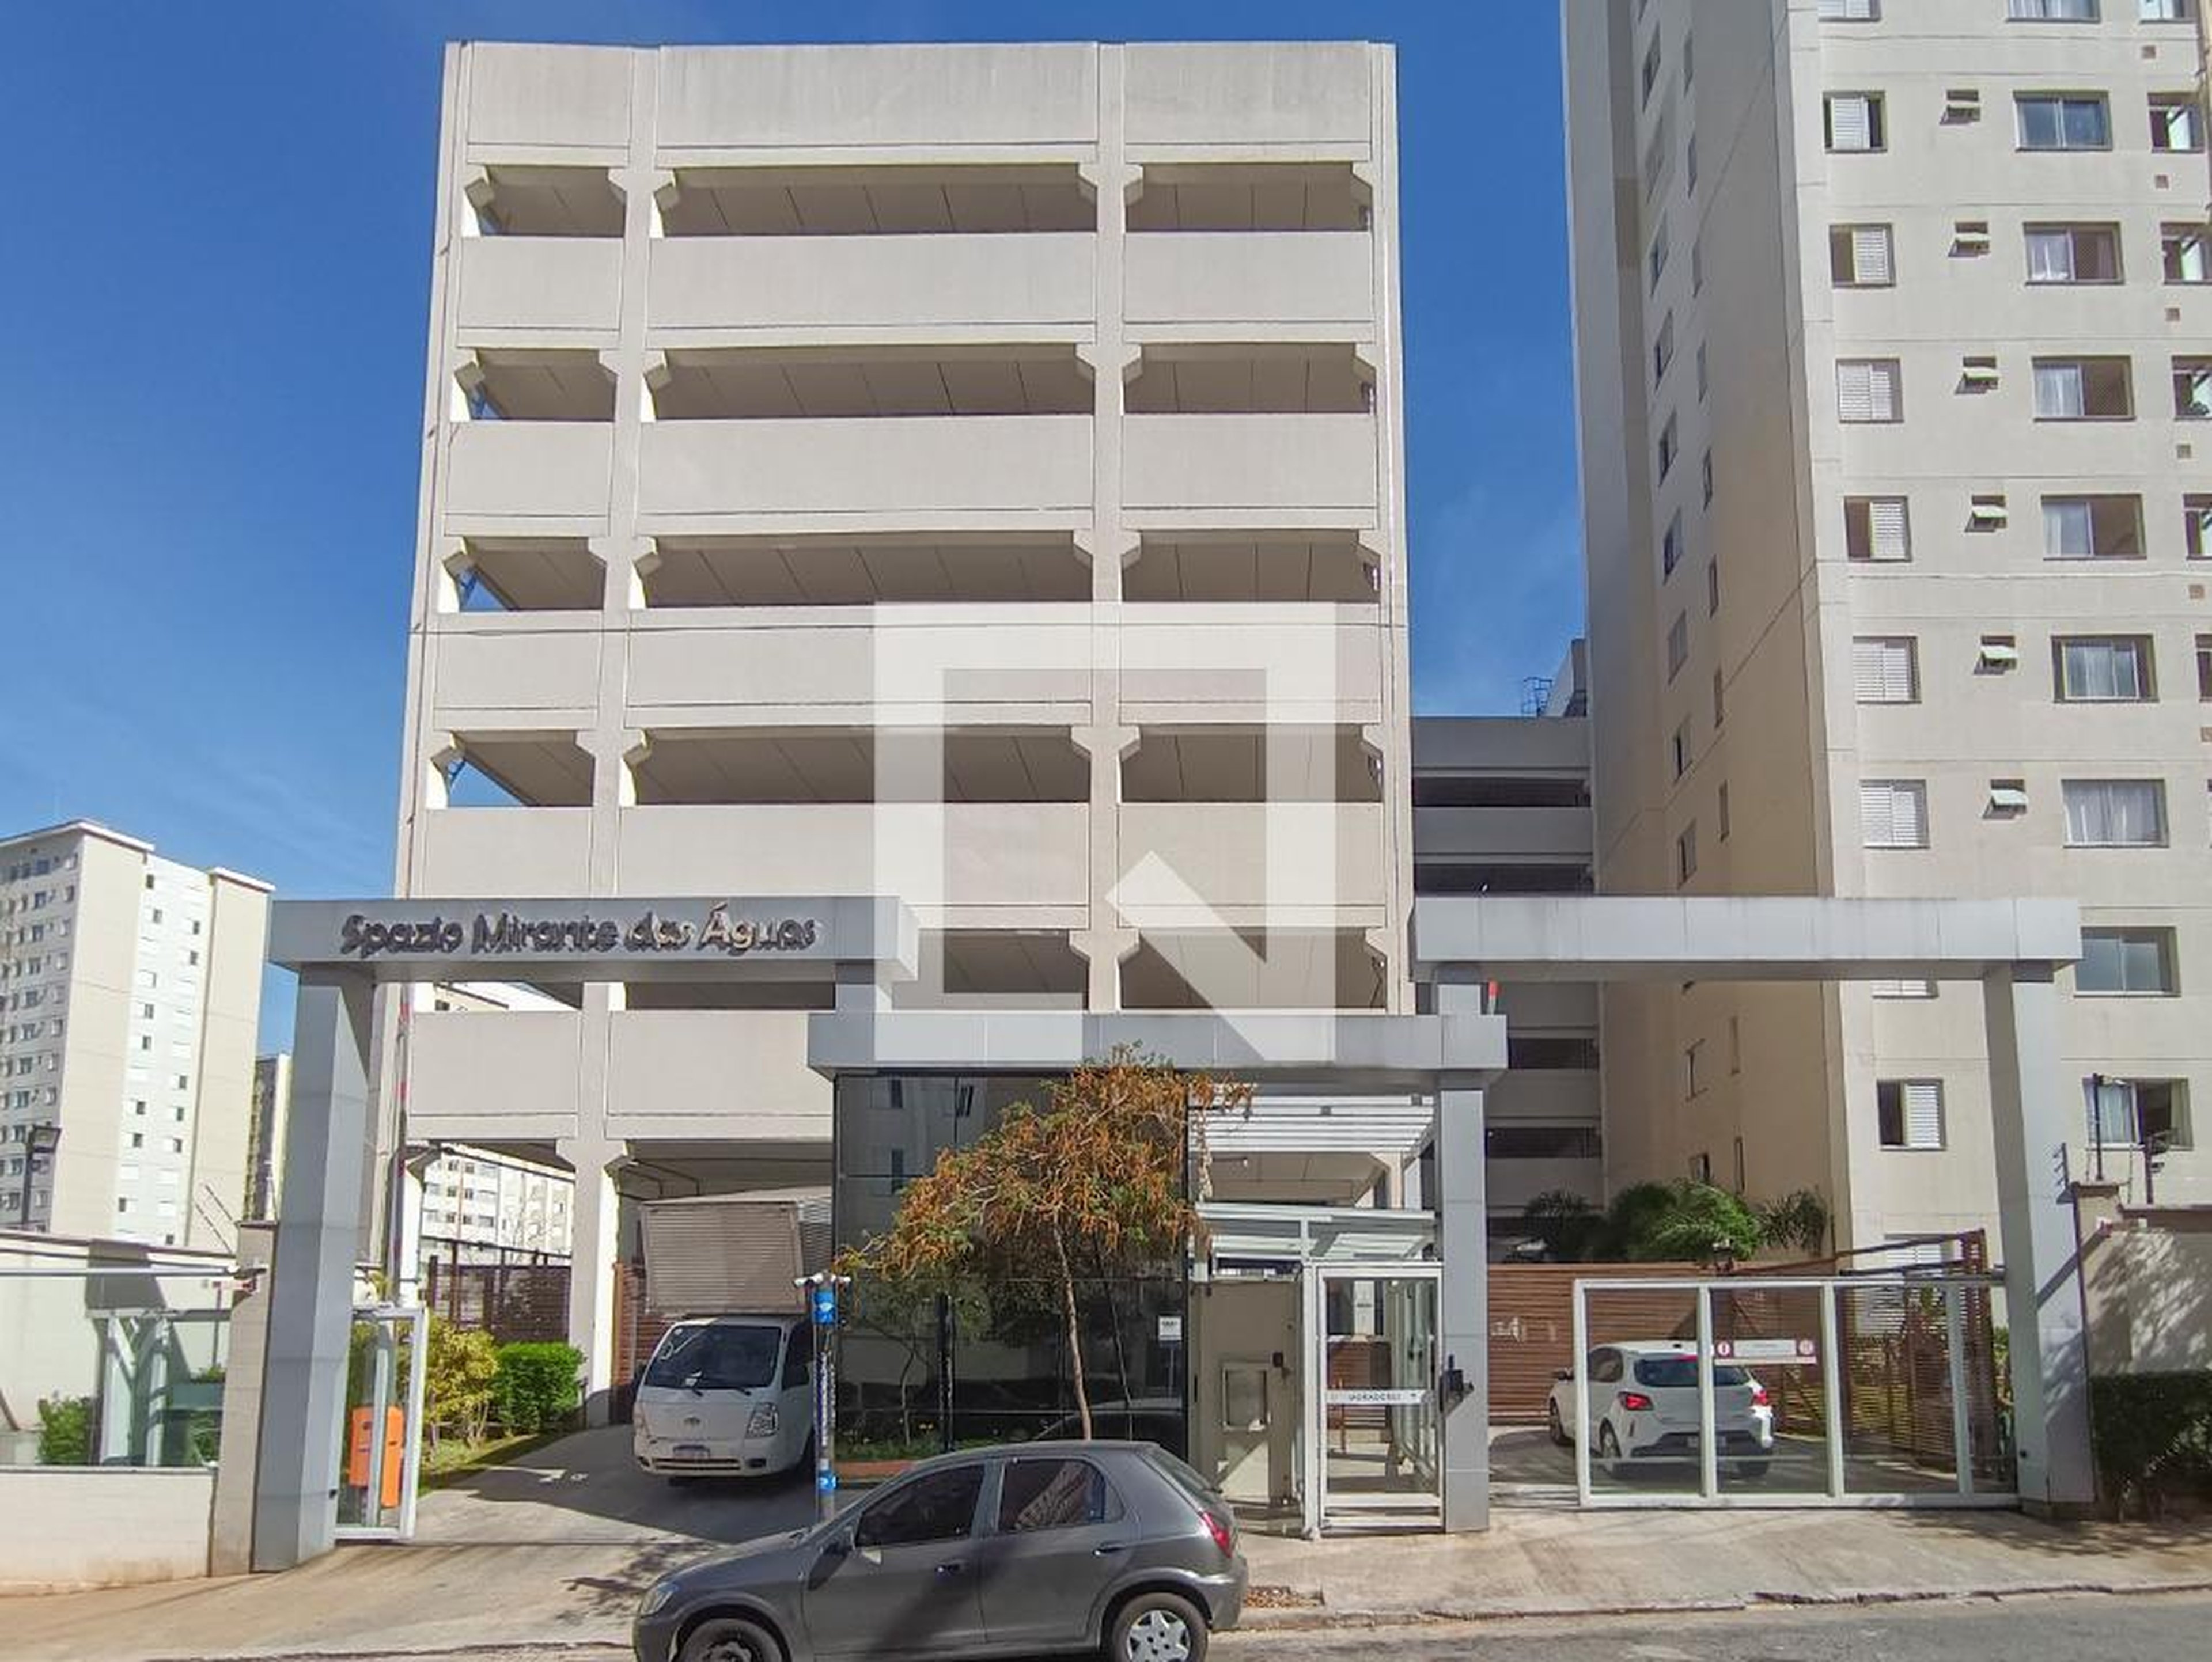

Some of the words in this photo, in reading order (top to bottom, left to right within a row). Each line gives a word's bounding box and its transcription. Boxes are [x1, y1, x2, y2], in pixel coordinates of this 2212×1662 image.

[341, 914, 463, 958] Spazio
[471, 913, 619, 954] Mirante
[623, 911, 692, 953] das
[696, 901, 817, 956] Águas
